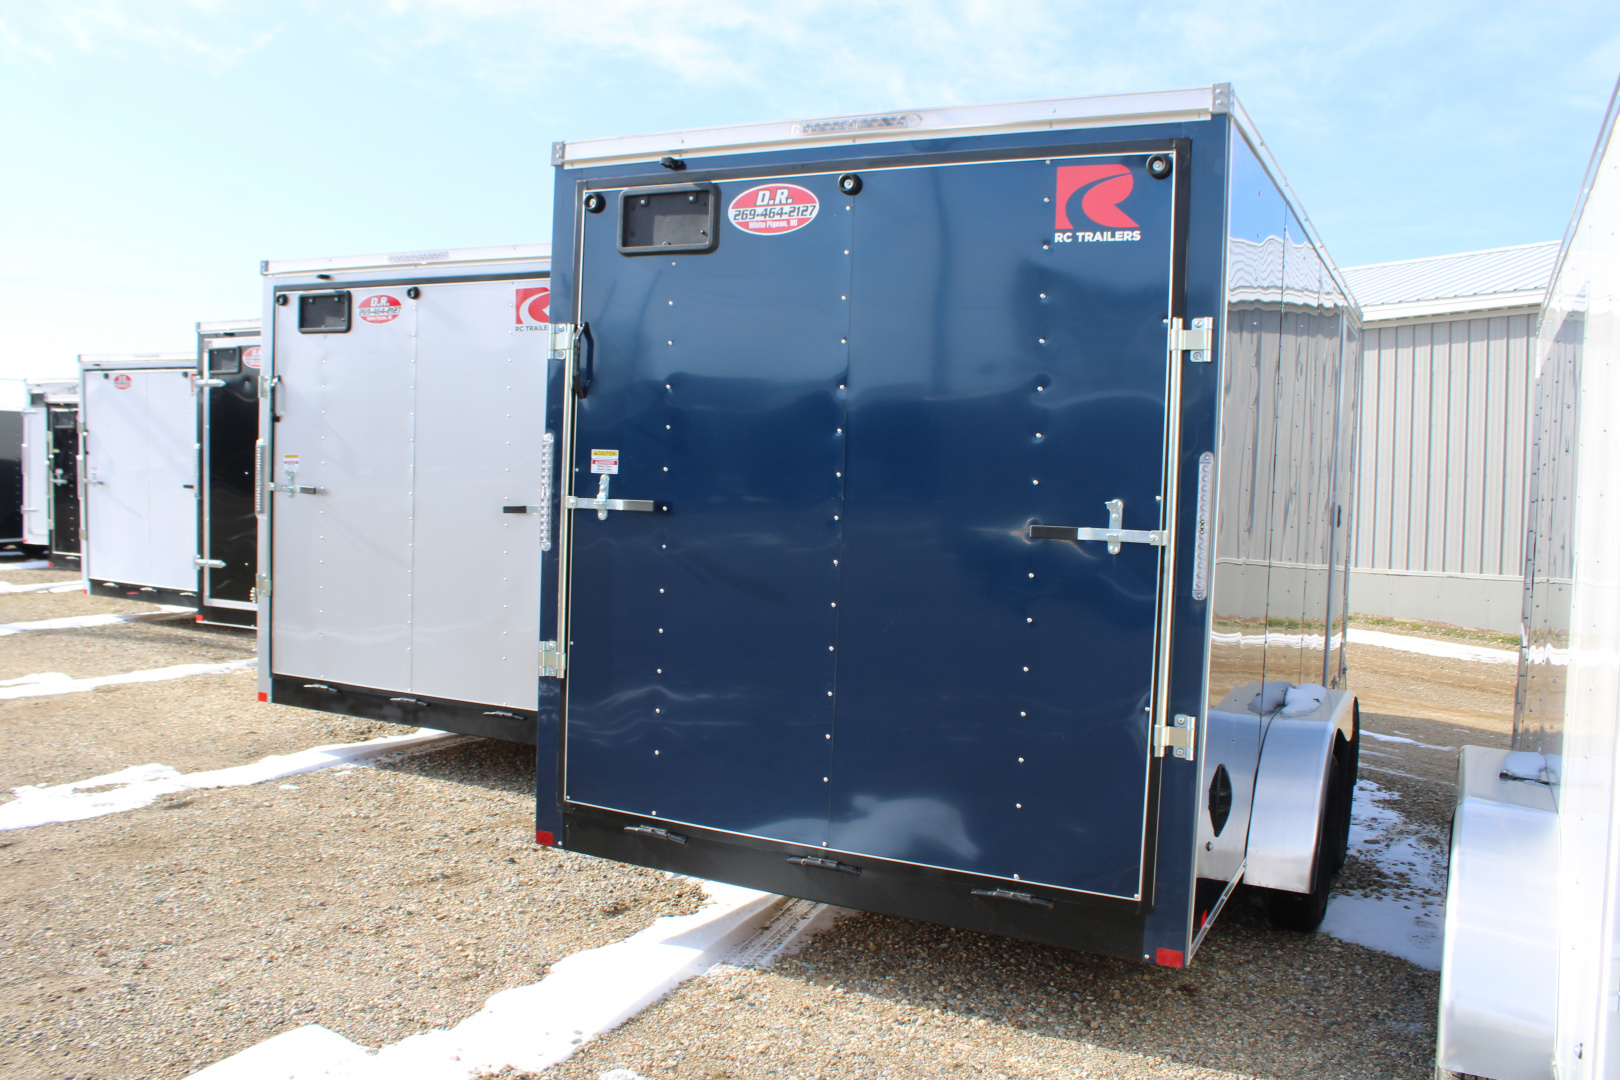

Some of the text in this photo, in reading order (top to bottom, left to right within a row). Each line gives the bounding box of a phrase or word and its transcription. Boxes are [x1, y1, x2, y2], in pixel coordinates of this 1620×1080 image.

[756, 188, 793, 206] D.R.
[733, 205, 816, 221] 269-464-2127
[790, 219, 798, 227] MI
[1054, 231, 1141, 243] RC TRAILERS
[370, 296, 390, 307] D.R.
